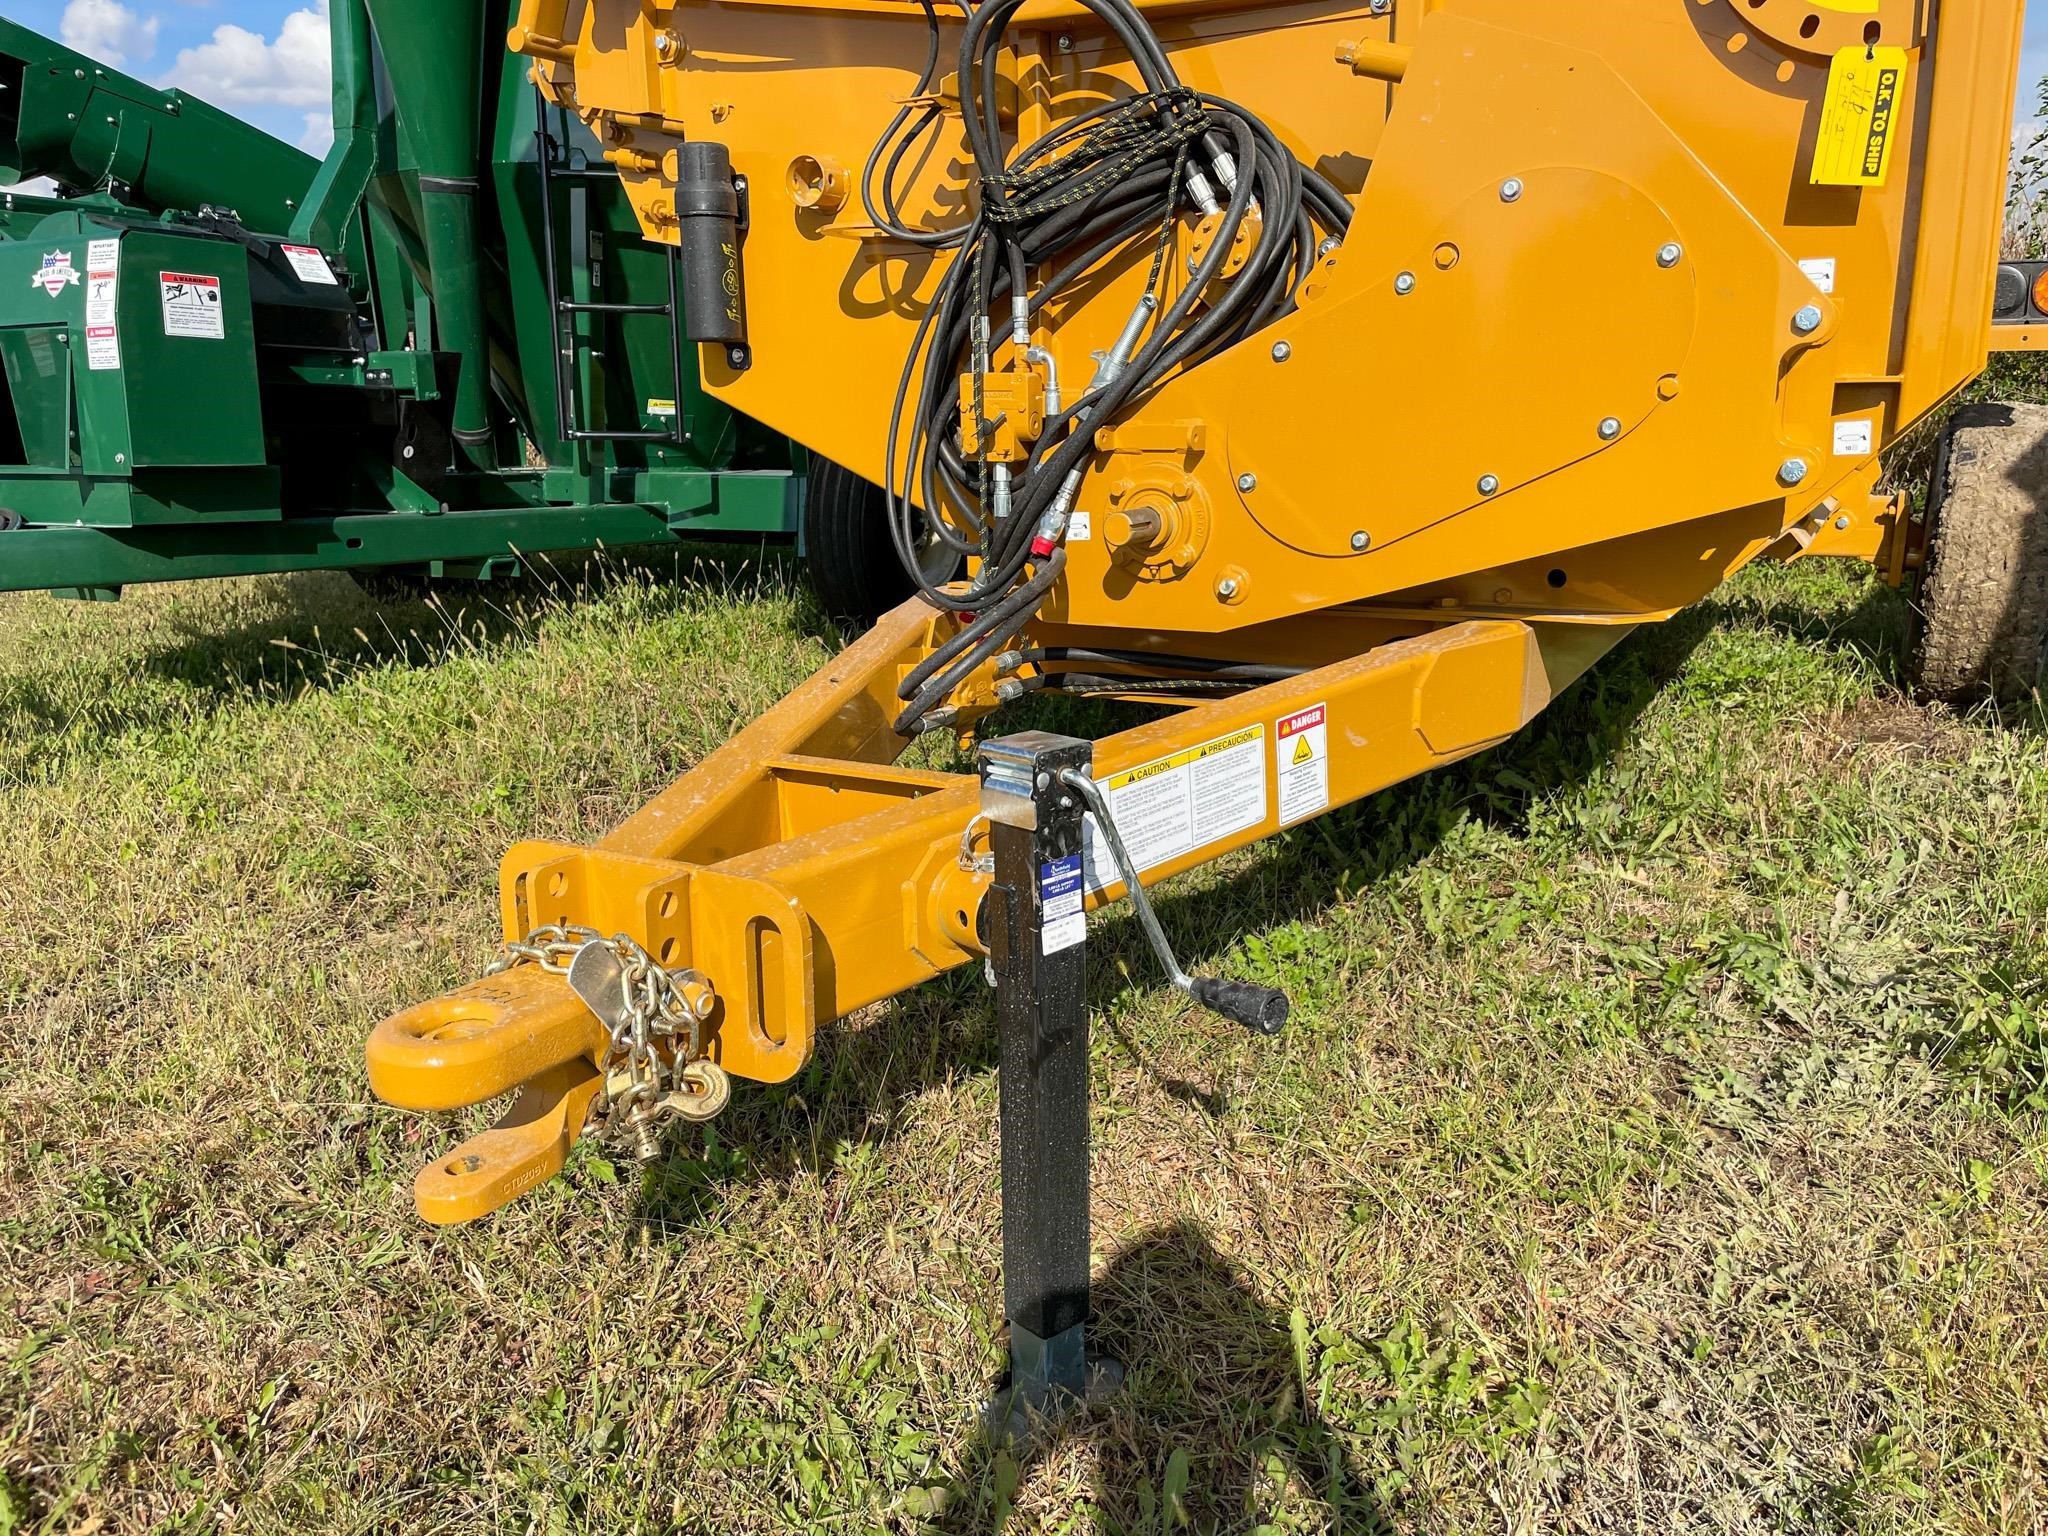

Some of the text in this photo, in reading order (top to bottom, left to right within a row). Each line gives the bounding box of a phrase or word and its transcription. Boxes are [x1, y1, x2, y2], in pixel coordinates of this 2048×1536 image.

[1867, 72, 1895, 174] O.K. TO SHIP
[56, 268, 73, 277] AMERICA
[179, 276, 208, 284] WARNING
[1291, 711, 1321, 731] DANGER
[1208, 731, 1254, 754] PRECAUCIÓN
[1137, 760, 1171, 780] CAUTION
